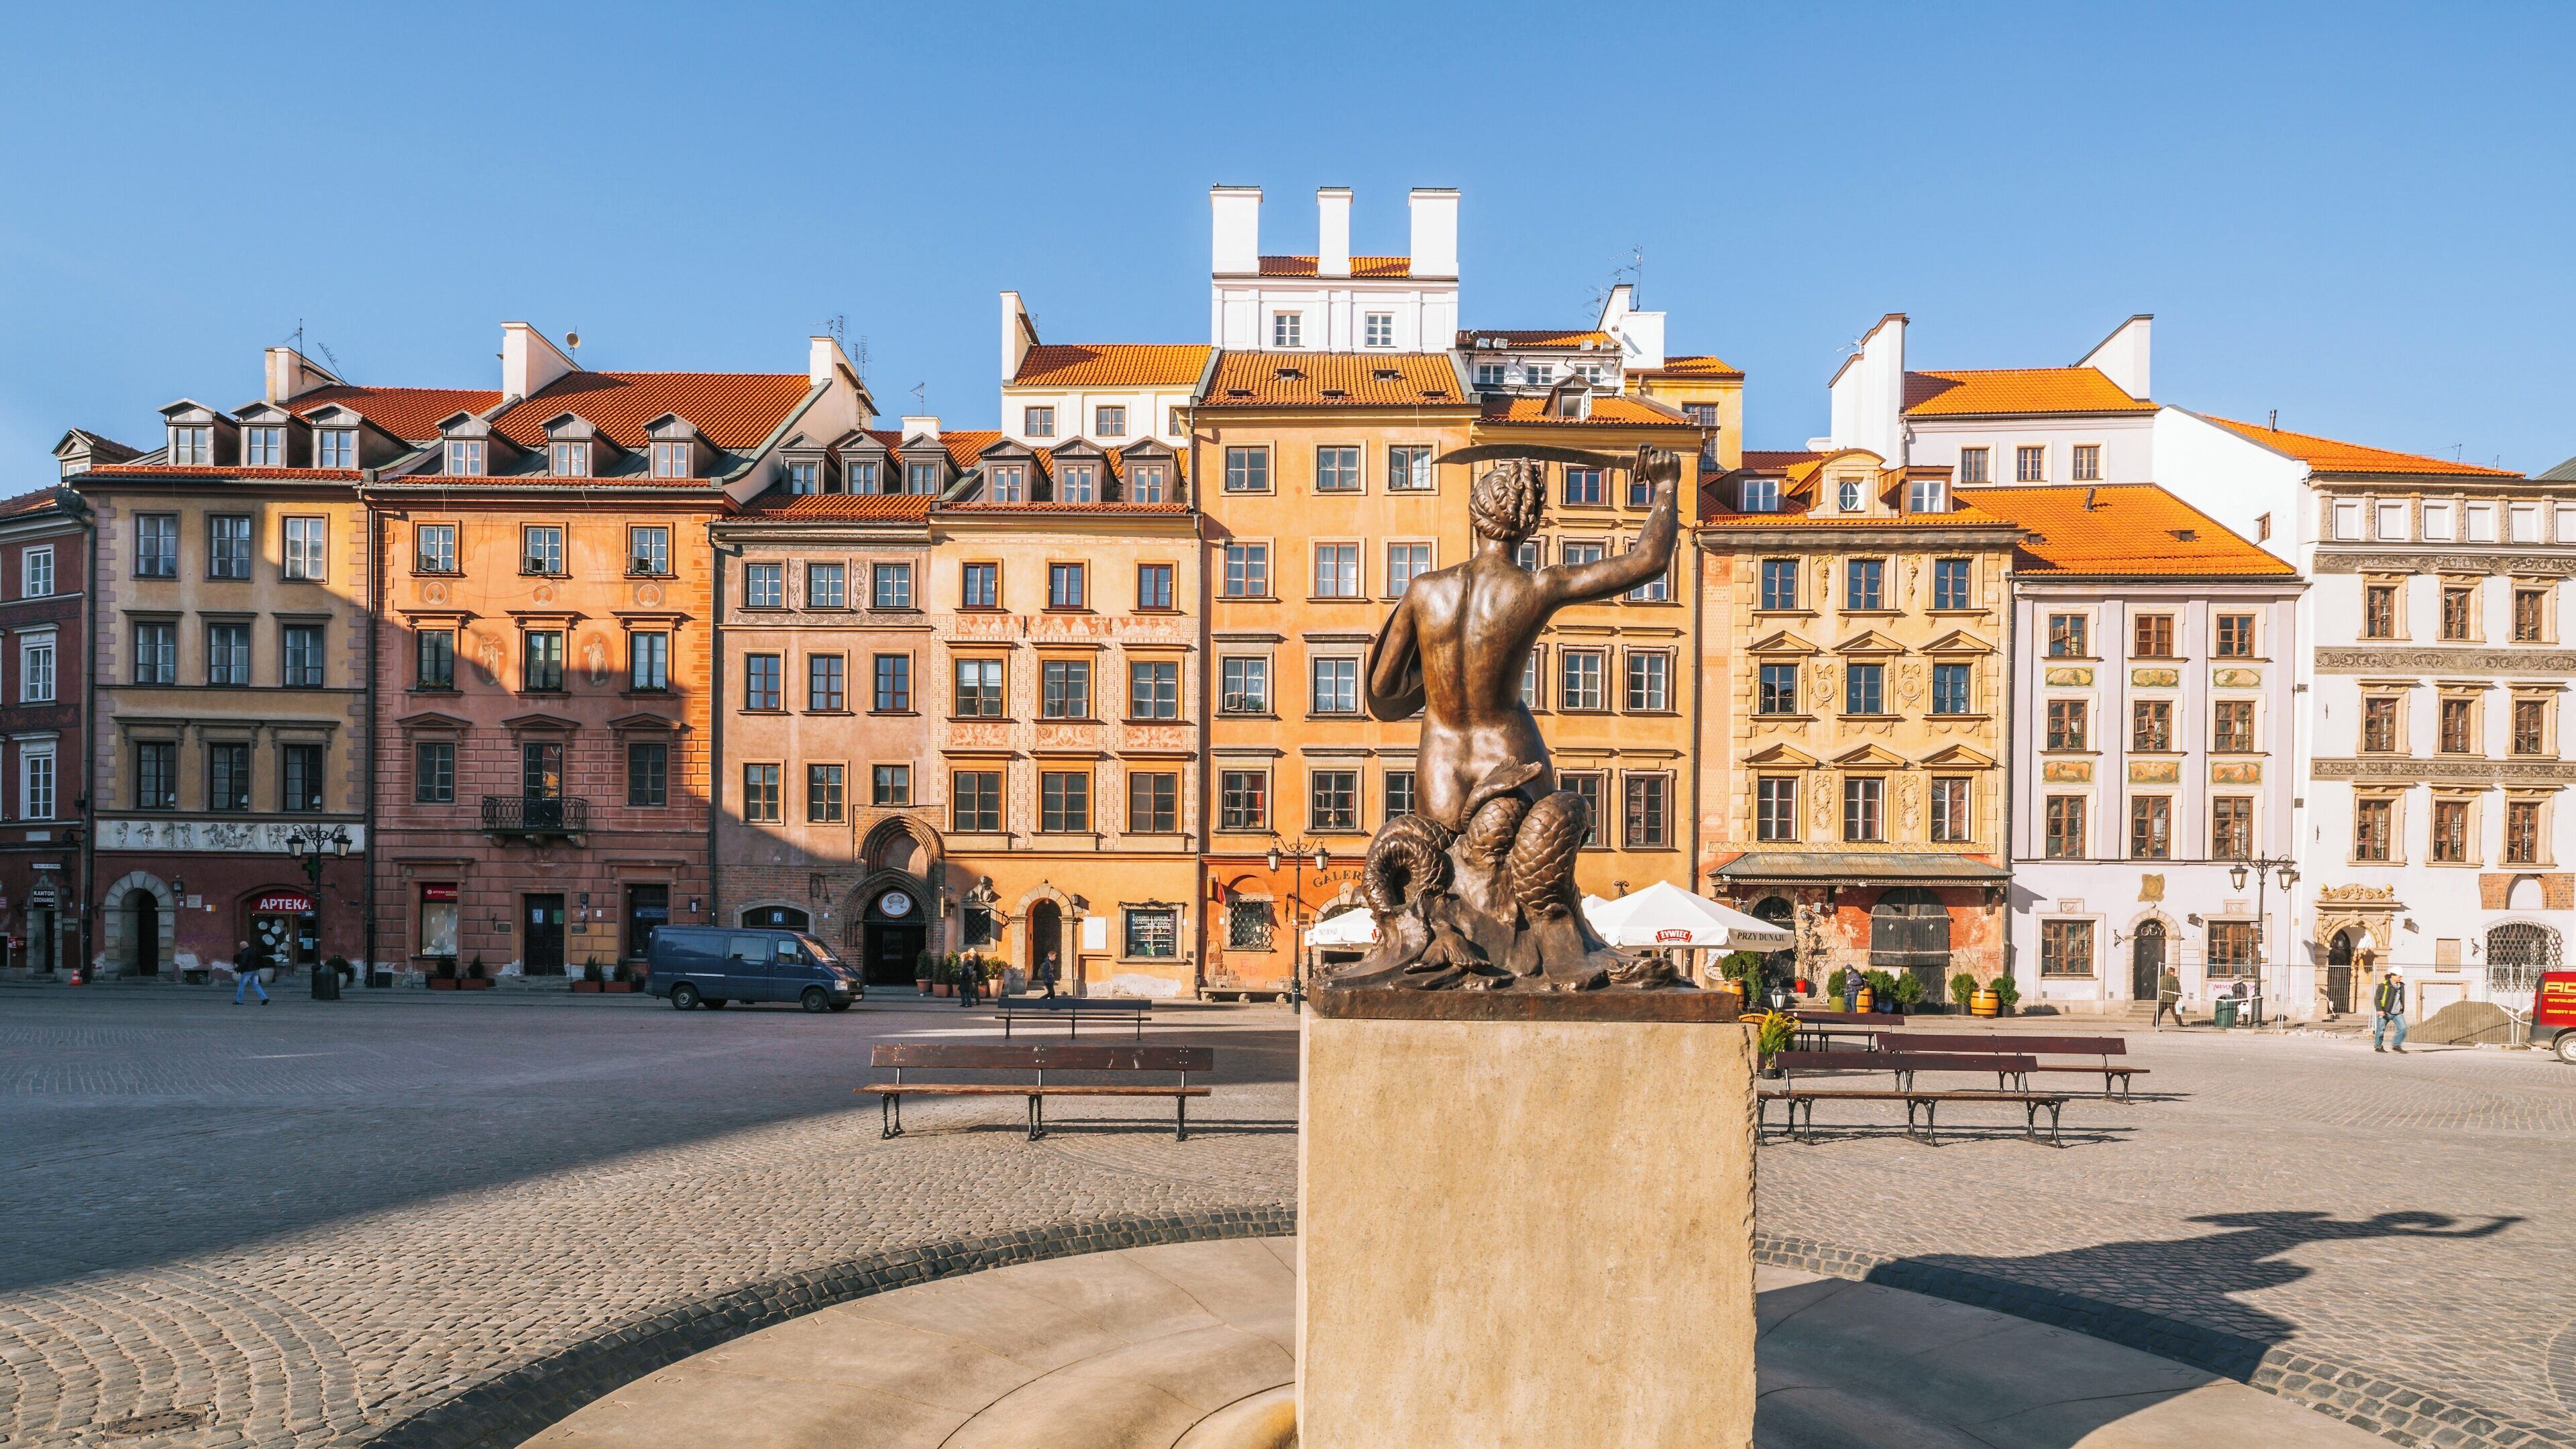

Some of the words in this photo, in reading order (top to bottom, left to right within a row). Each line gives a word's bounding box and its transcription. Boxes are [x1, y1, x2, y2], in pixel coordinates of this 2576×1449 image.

[1313, 870, 1362, 888] GALER
[260, 898, 311, 910] APTEKA
[1737, 932, 1758, 941] PRZY
[1759, 933, 1786, 942] DUNAJU
